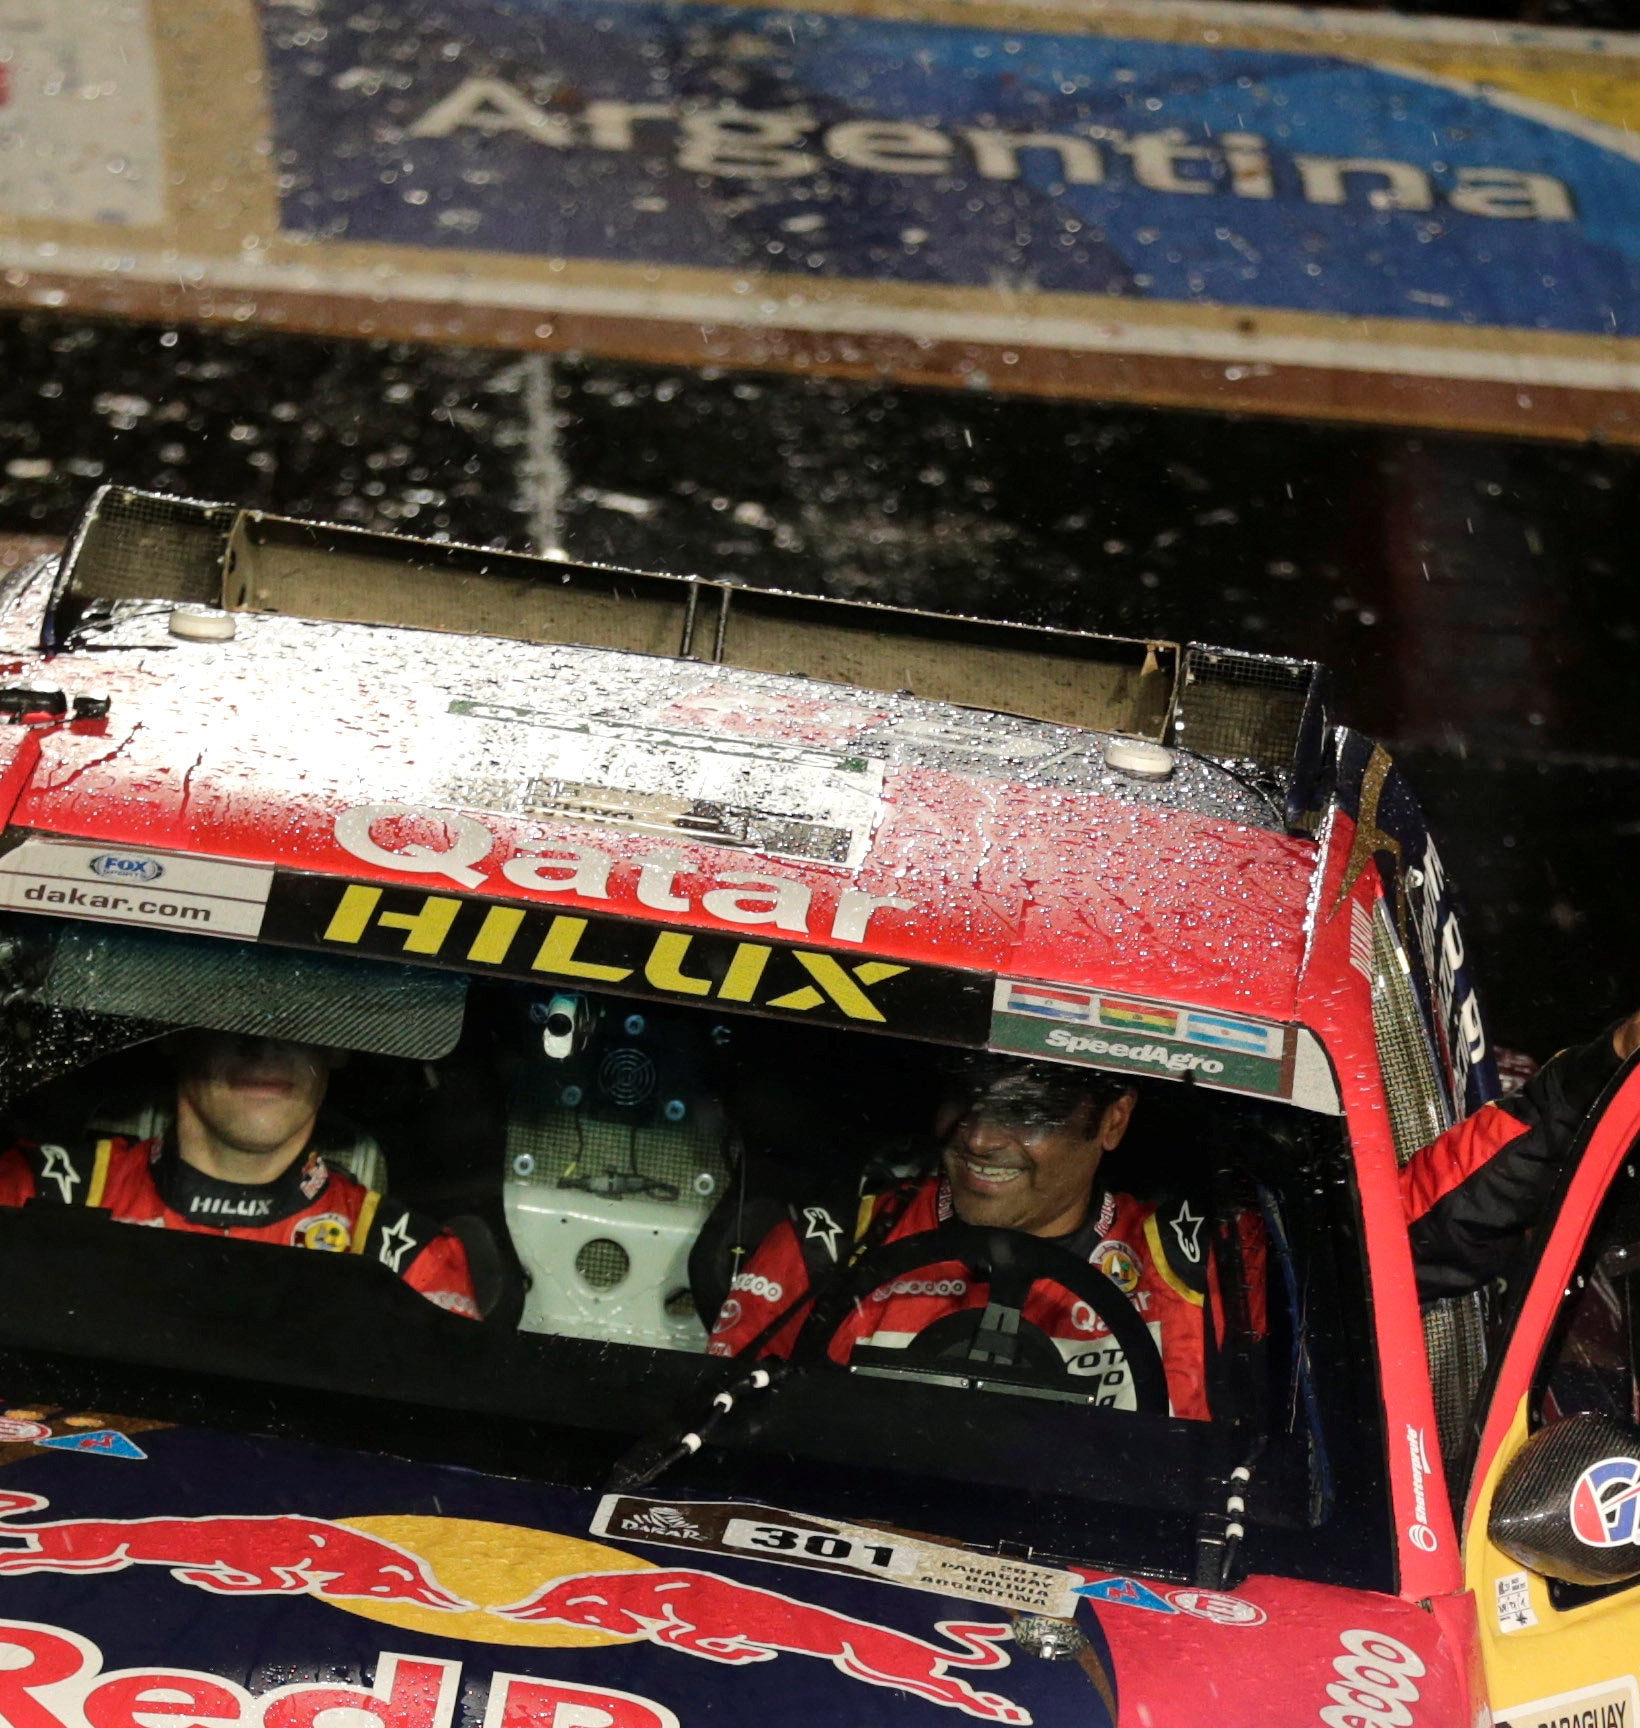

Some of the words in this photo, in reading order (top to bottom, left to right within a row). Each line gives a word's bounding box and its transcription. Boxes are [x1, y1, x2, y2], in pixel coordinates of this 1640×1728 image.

[407, 77, 1577, 224] Argentina
[104, 857, 148, 873] FOX
[334, 804, 919, 942] Qatar
[24, 883, 212, 922] dakar.com
[323, 885, 910, 1022] HILUX
[1045, 1028, 1225, 1074] SpeedAgro
[190, 1195, 272, 1217] HILUX
[1406, 1426, 1428, 1524] Shatterprufe
[620, 1518, 709, 1542] DAKAR
[751, 1526, 895, 1567] 301
